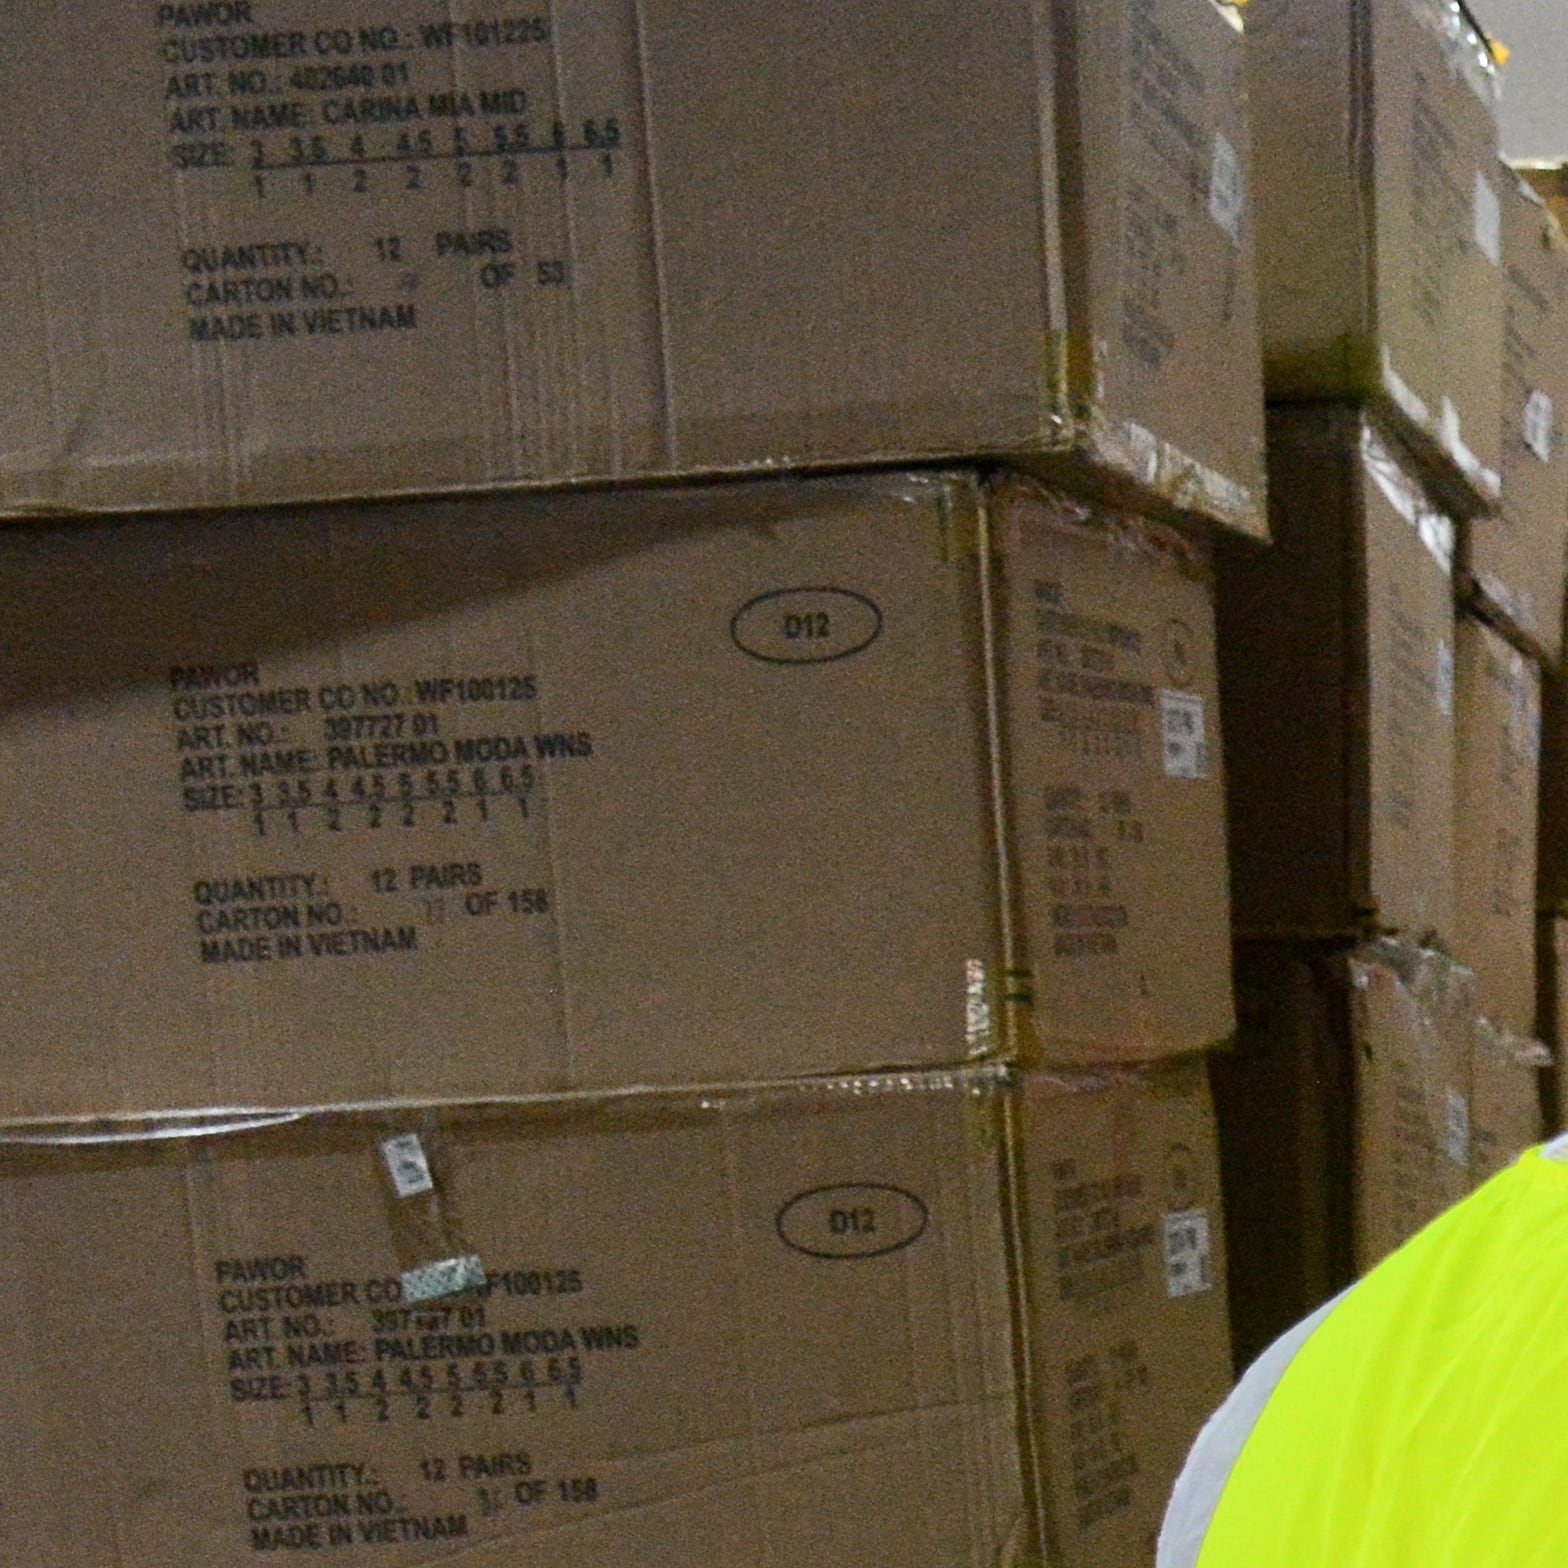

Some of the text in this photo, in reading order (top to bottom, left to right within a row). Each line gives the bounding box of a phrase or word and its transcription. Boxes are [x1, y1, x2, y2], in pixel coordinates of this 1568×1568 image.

[163, 28, 307, 63] CUSTOMER
[314, 28, 353, 55] CO
[322, 98, 420, 124] CARINA
[428, 93, 474, 117] MIA
[480, 89, 526, 114] MID
[373, 237, 400, 262] 12
[436, 228, 513, 257] PAIRS
[186, 276, 293, 306] CARTON
[480, 262, 514, 290] OF
[189, 304, 417, 341] MADE IN VIETNAM
[174, 688, 312, 722] CUSTOMER
[319, 686, 354, 711] CO
[328, 741, 448, 771] PALERMO
[454, 735, 528, 763] MODA
[534, 731, 594, 759] WNS
[370, 868, 396, 893] 12
[410, 862, 483, 889] PAIRS
[197, 903, 301, 934] CARTON
[465, 890, 498, 916] OF
[200, 926, 418, 964] MADE IN VIETNAM
[216, 1254, 305, 1283] PAWOR
[219, 1278, 402, 1314] CUSTOMER CO
[375, 1333, 495, 1362] PALERMO
[501, 1328, 576, 1354] MODA
[582, 1323, 640, 1350] WNS
[419, 1458, 445, 1482] 12
[459, 1451, 532, 1479] PAIRS
[248, 1494, 352, 1521] CARTON
[515, 1479, 546, 1505] OF
[251, 1514, 468, 1551] MADE IN VIETNAM
